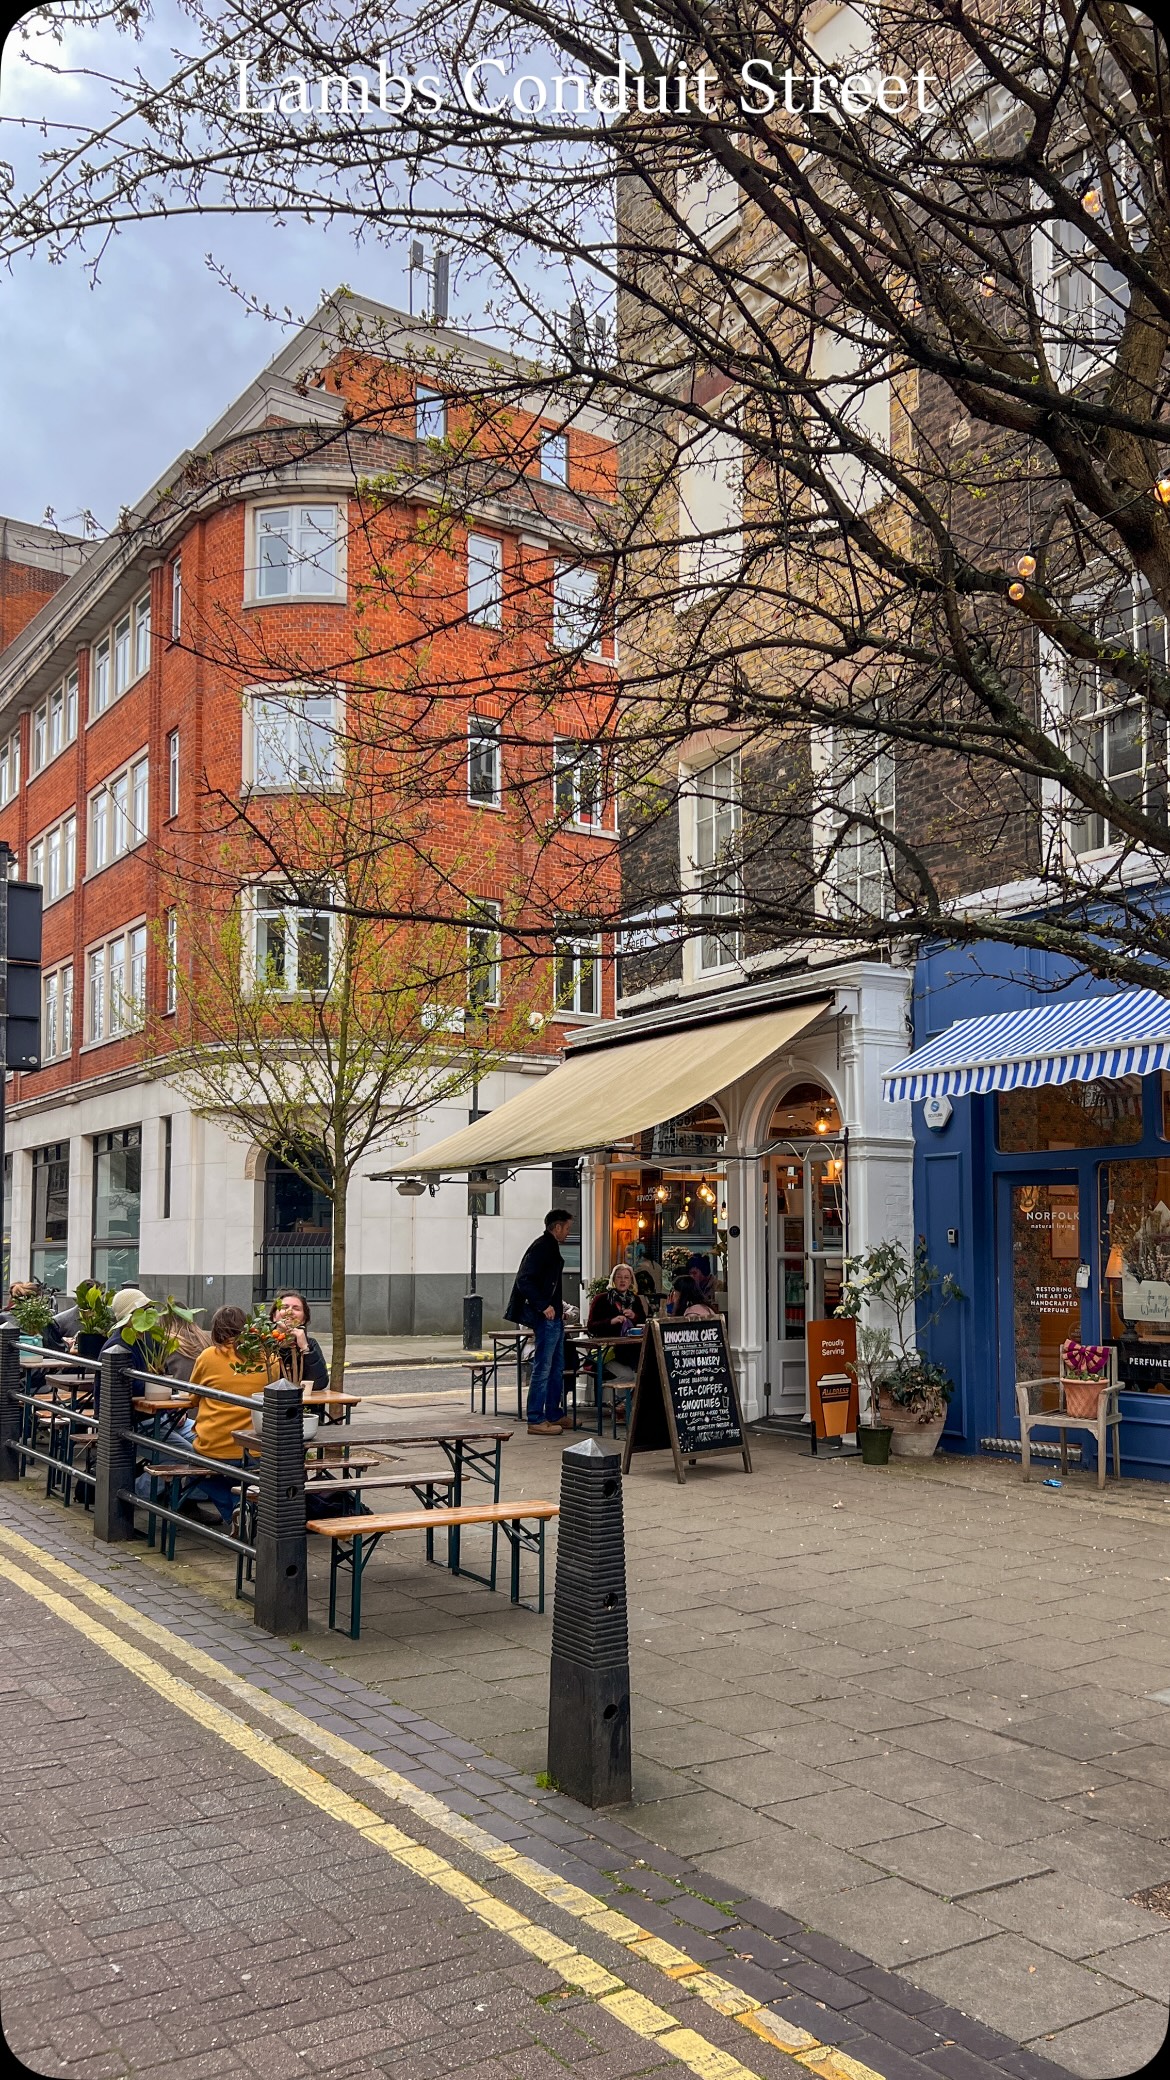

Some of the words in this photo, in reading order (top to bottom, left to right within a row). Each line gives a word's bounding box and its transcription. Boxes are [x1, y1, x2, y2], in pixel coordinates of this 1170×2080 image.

[1026, 1211, 1080, 1220] NORFOLK
[1056, 1223, 1076, 1231] living
[663, 1329, 700, 1343] KNOCKBOX
[700, 1328, 719, 1341] CAFE
[821, 1339, 845, 1348] Proudly
[821, 1347, 845, 1356] Serving
[696, 1356, 720, 1367] BAKERY
[697, 1383, 723, 1396] COFFEE
[681, 1398, 721, 1411] SMOOTHIES
